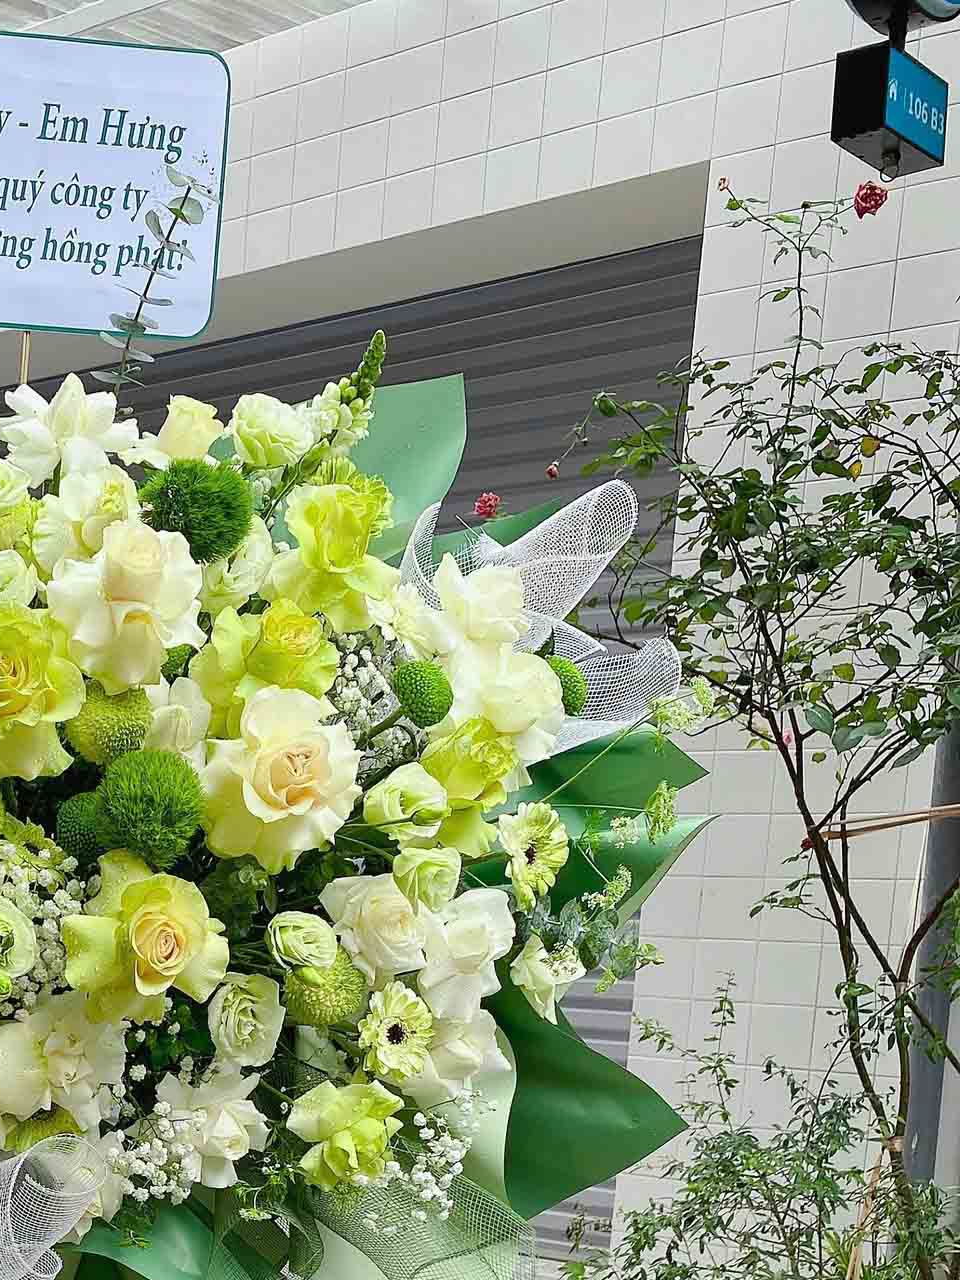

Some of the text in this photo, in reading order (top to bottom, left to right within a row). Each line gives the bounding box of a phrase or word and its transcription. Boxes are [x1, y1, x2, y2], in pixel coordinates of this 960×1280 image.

[36, 102, 88, 145] Em
[97, 107, 187, 164] Hưng
[908, 91, 928, 125] 106
[50, 173, 117, 220] công
[121, 181, 150, 223] ty
[39, 226, 110, 276] hồng
